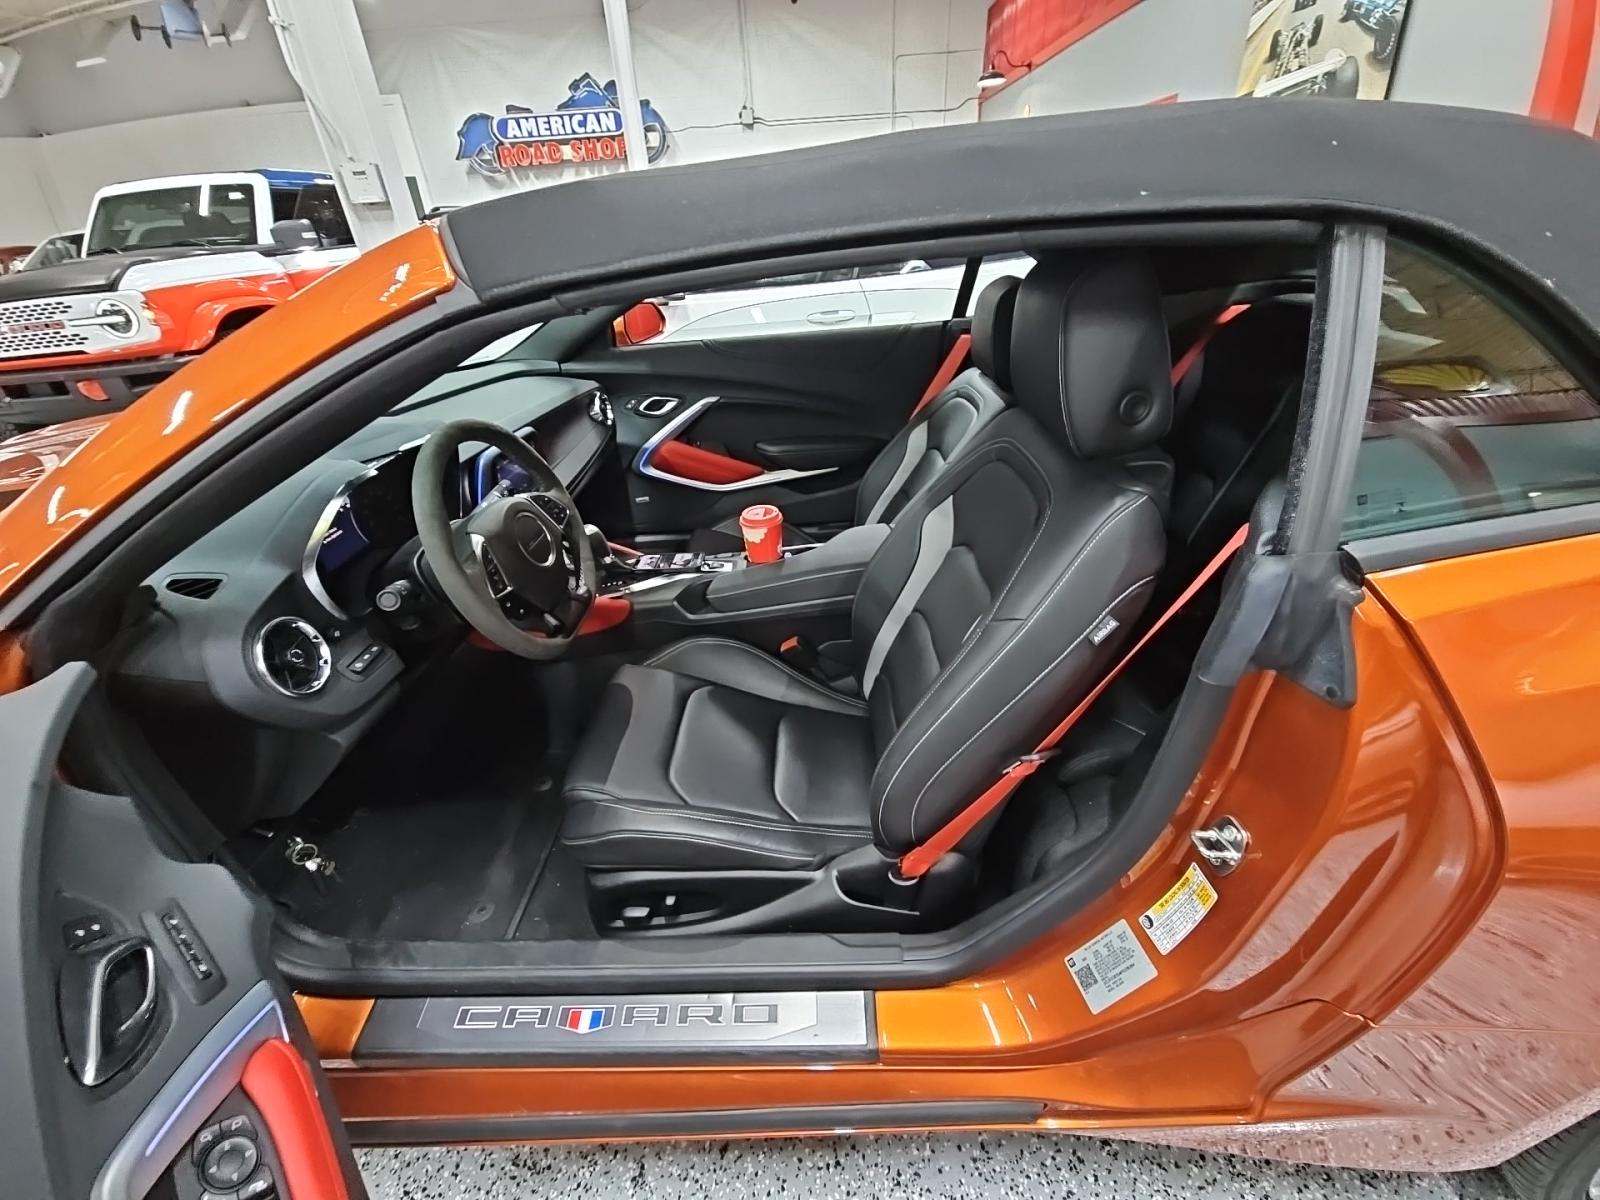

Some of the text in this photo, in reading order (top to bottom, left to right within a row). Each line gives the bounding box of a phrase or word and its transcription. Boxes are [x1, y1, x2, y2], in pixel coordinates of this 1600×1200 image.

[506, 112, 616, 138] AMERICAN
[498, 141, 562, 168] ROAD
[453, 1003, 778, 1034] CAMARO
